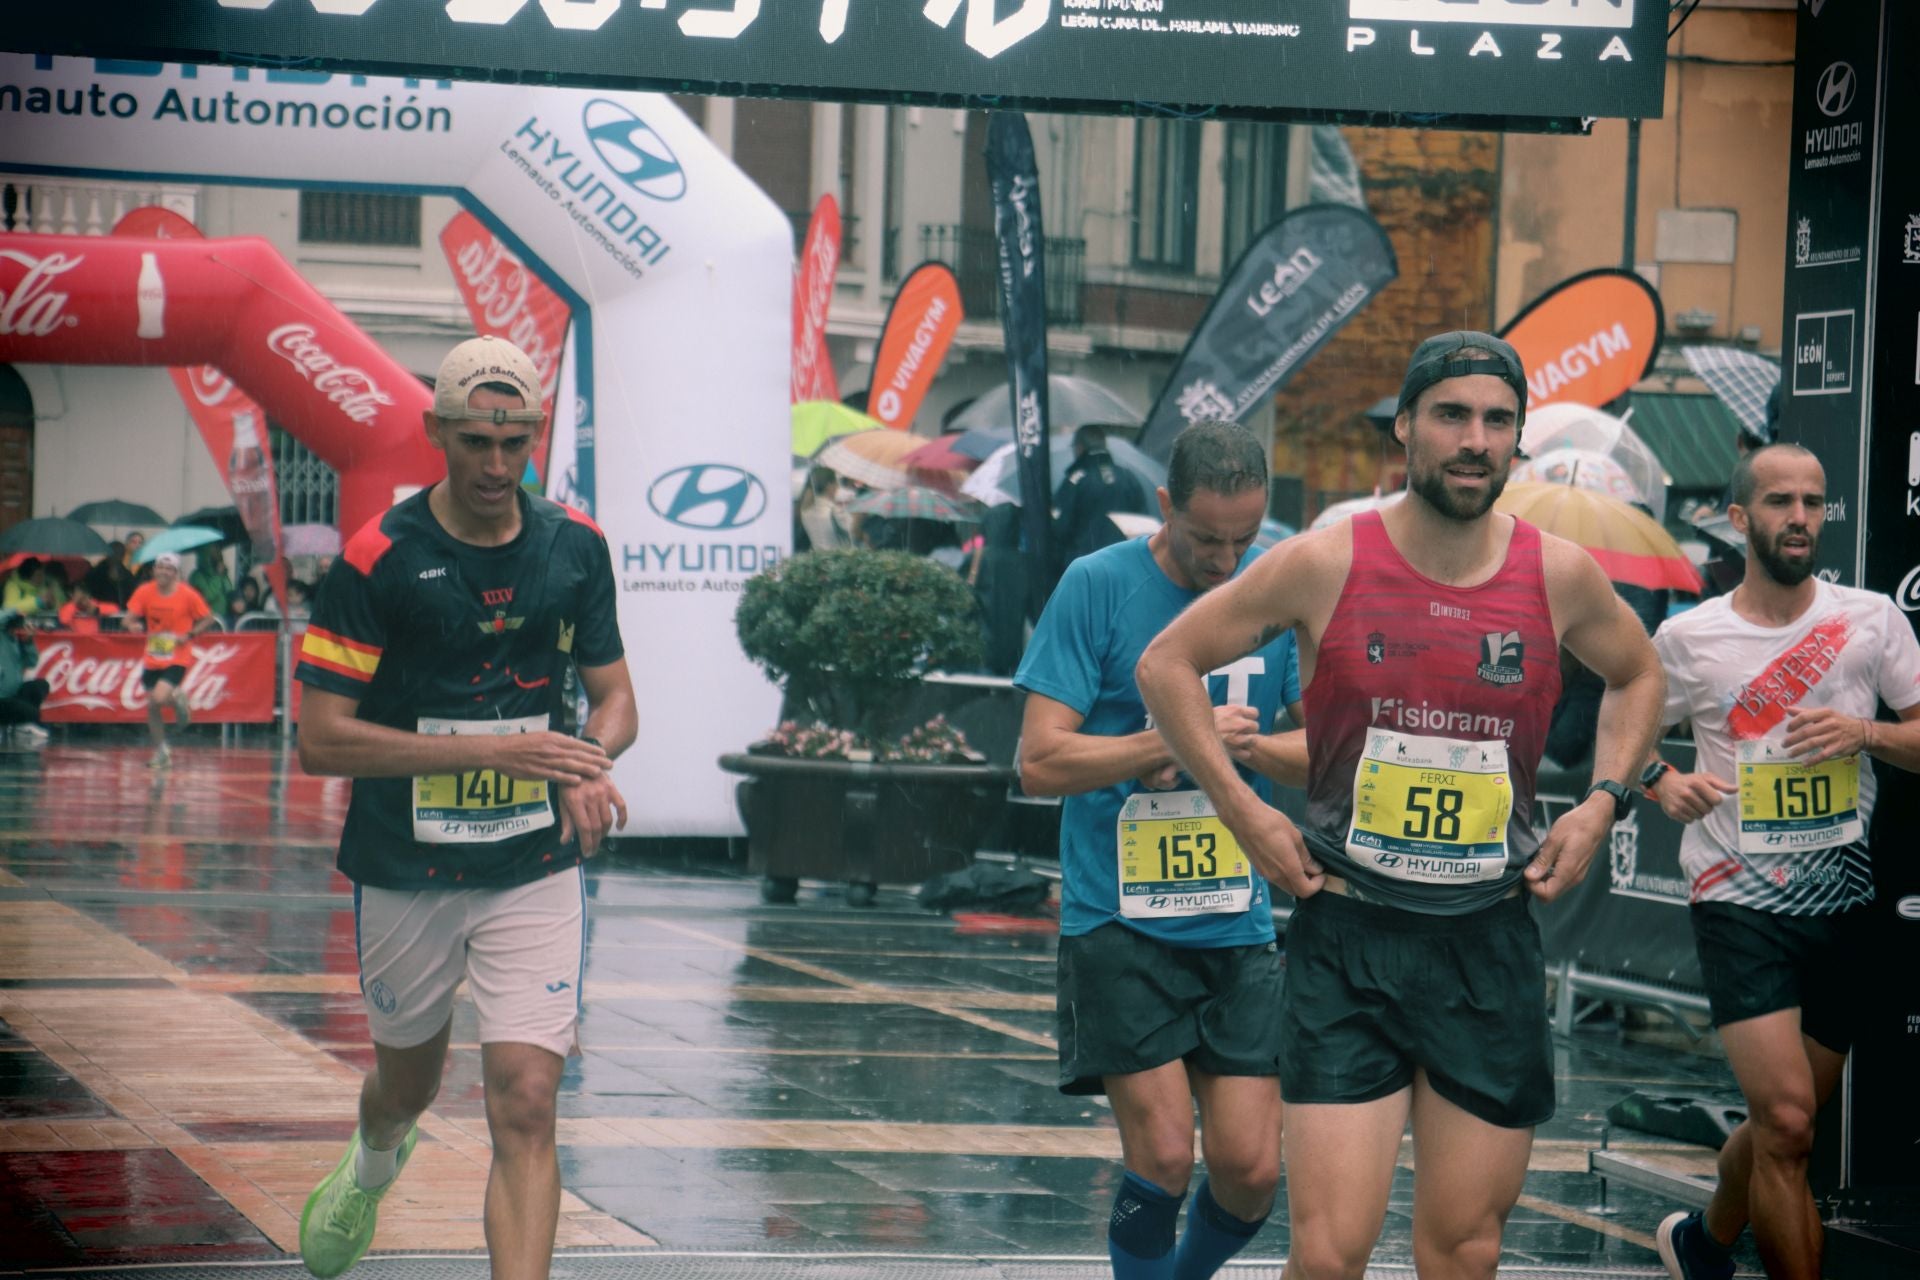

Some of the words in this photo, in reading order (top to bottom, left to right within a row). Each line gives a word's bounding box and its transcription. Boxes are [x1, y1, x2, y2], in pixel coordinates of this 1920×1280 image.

[153, 87, 452, 132] Automoción
[1805, 120, 1863, 154] HYUNDAI
[514, 116, 671, 266] HYUNDAI
[500, 140, 560, 200] Lemauto
[560, 200, 643, 279] Automoción
[892, 296, 948, 392] VIVAGYM
[1798, 338, 1823, 364] LEÓN
[267, 322, 396, 427] Coca-Cola
[623, 579, 696, 592] Lemauto
[1477, 667, 1523, 684] FISIORAMA
[1744, 633, 1830, 718] DESPENSA
[456, 769, 514, 807] 140
[1420, 772, 1457, 786] FERXI
[1403, 786, 1464, 841] 58
[1773, 775, 1831, 818] 150
[467, 818, 530, 835] HYUNDAI
[1172, 821, 1202, 833] NIETO
[1789, 827, 1843, 844] HYUNDAI
[1157, 832, 1218, 881] 153
[1406, 869, 1437, 878] Lemauto
[1407, 858, 1480, 874] HYUNDAI
[1173, 893, 1234, 907] HYUNDAI
